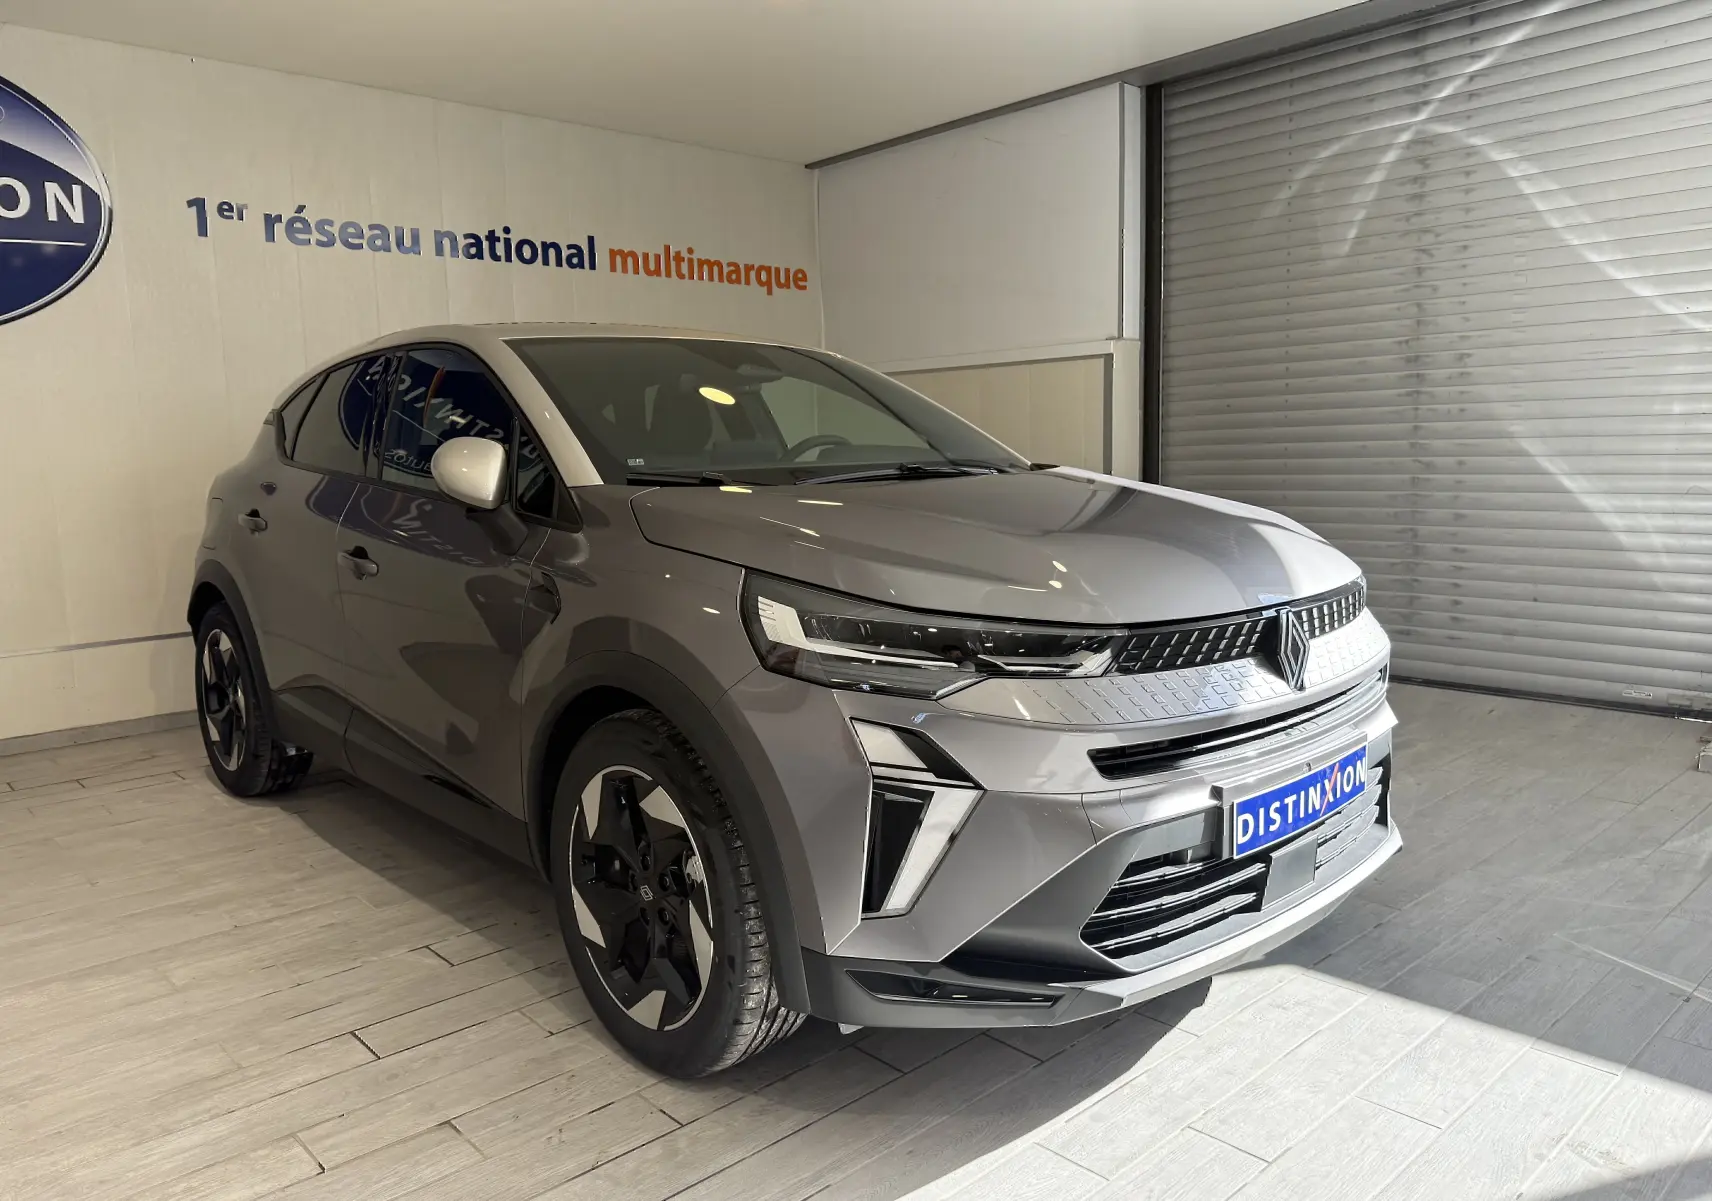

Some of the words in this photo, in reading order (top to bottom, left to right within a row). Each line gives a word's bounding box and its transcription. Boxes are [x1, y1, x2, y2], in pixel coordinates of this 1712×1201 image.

[263, 204, 422, 256] réseau
[433, 225, 597, 271] national
[608, 243, 809, 296] multimarque
[1237, 756, 1367, 845] DISTINXION
